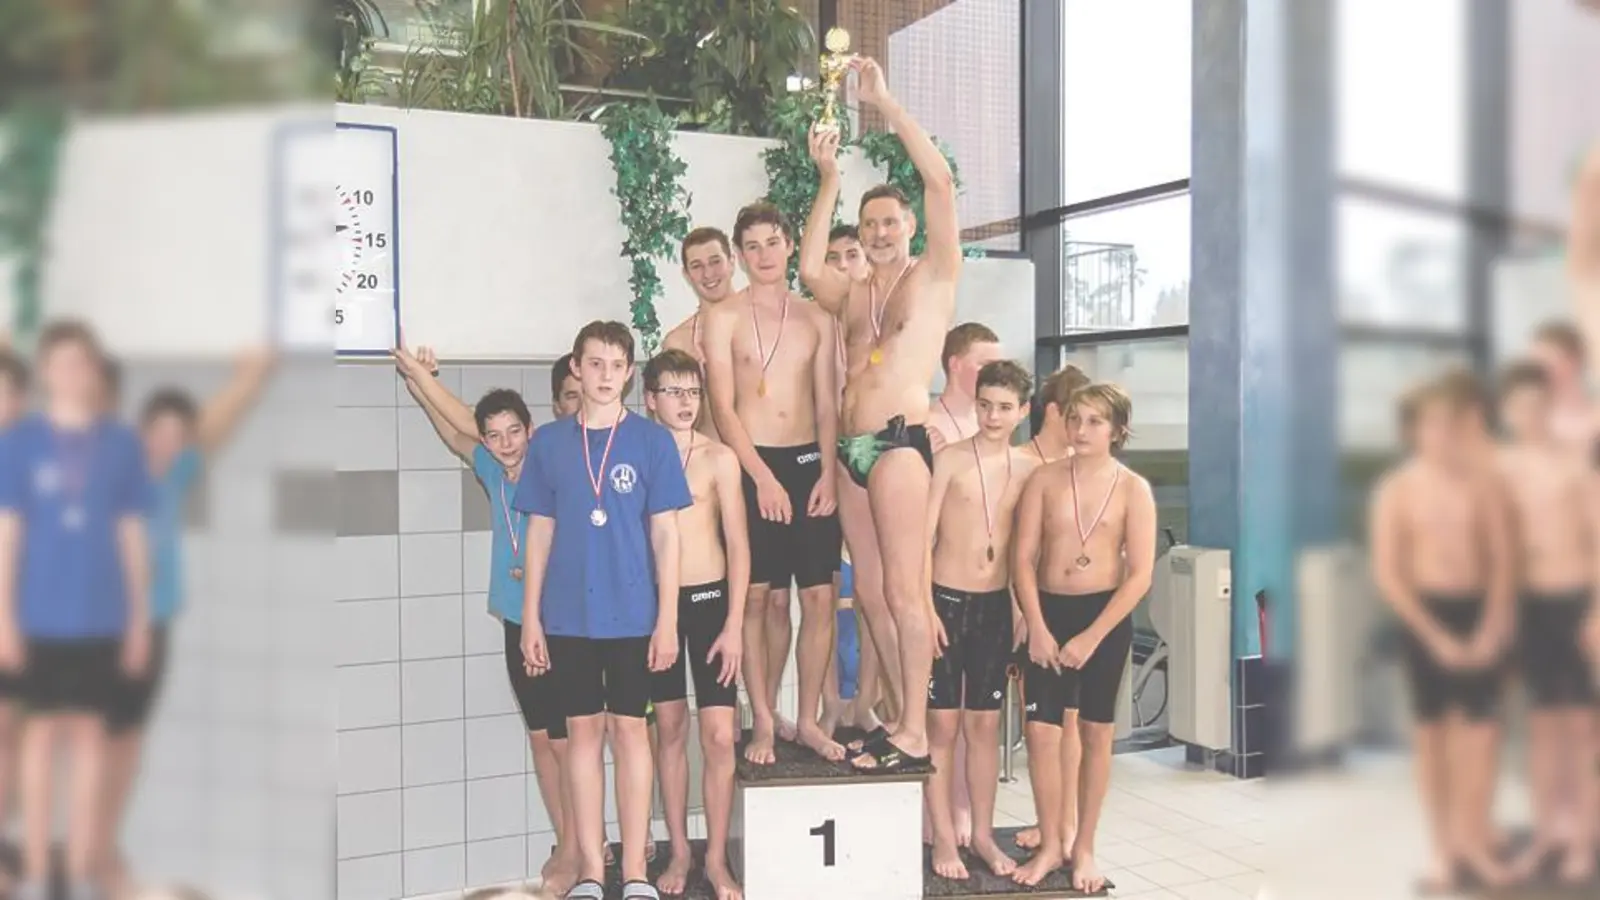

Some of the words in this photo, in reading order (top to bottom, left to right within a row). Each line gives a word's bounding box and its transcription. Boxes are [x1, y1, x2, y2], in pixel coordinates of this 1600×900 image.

[353, 190, 374, 206] 10
[365, 233, 386, 248] 15
[356, 274, 378, 289] 20
[336, 309, 344, 324] 5
[809, 819, 835, 867] 1
